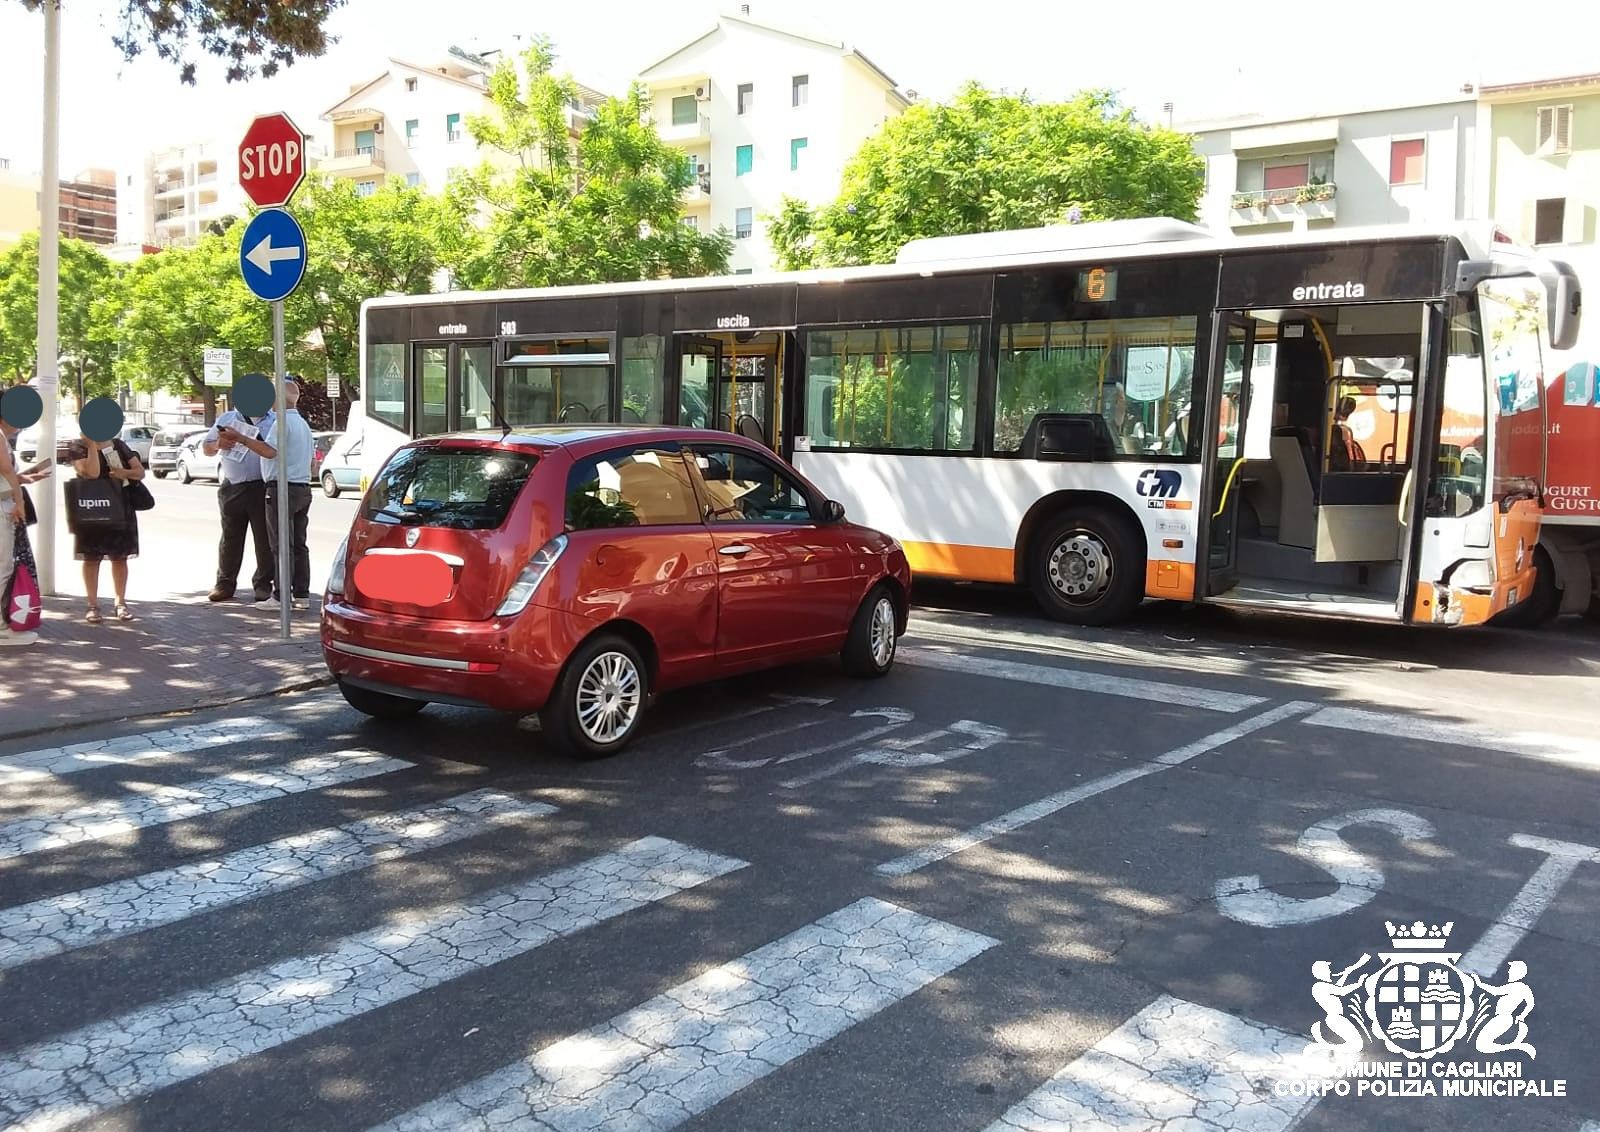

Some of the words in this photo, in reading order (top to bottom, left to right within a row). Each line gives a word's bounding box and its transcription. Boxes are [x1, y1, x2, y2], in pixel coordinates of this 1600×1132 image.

[242, 141, 299, 180] STOP
[1088, 268, 1106, 299] 6
[1292, 281, 1365, 300] entrata
[501, 321, 516, 335] 503
[717, 313, 750, 328] uscita
[439, 323, 467, 335] entrata
[78, 498, 111, 510] upim
